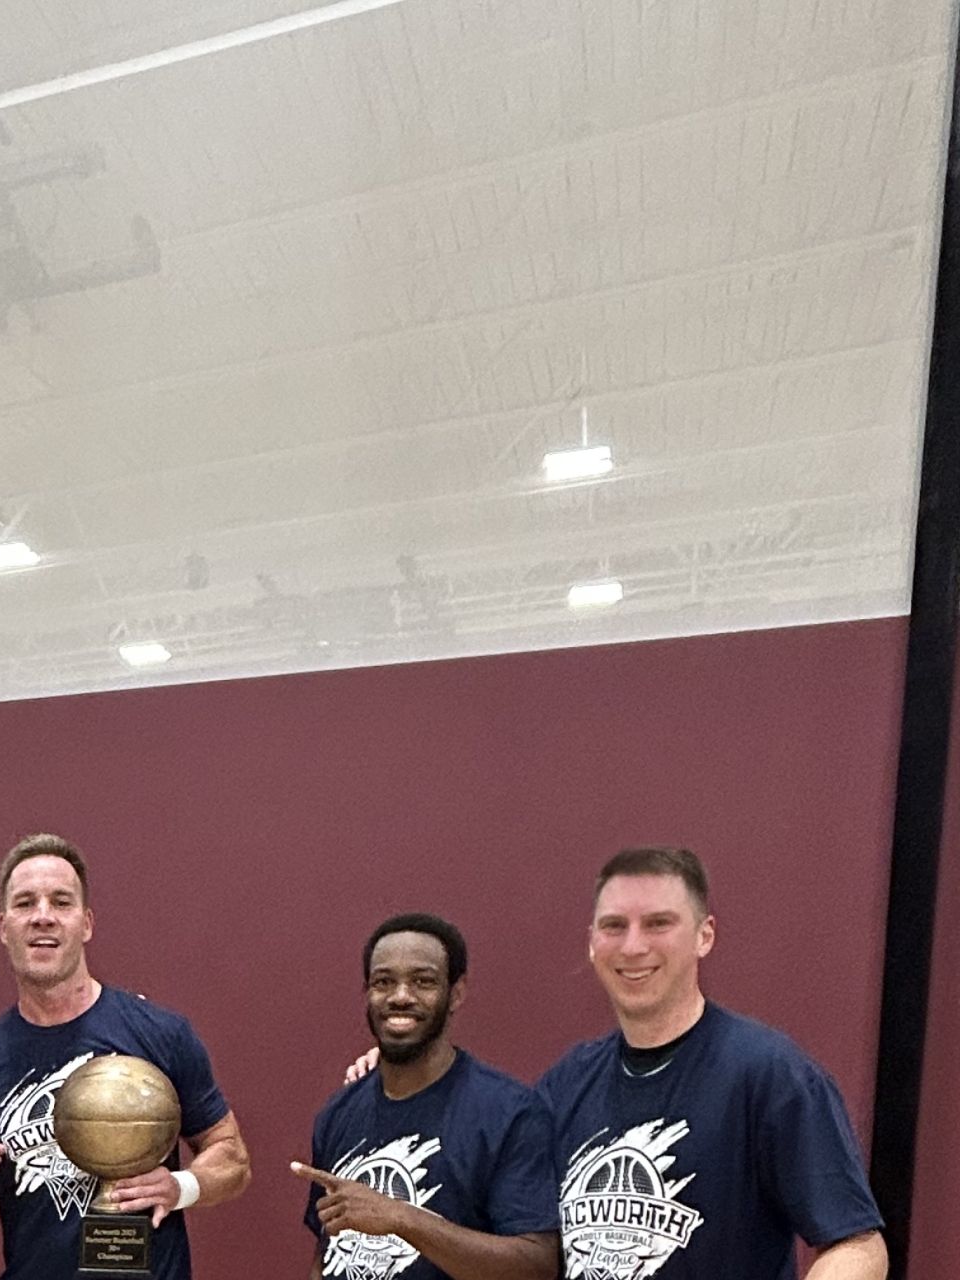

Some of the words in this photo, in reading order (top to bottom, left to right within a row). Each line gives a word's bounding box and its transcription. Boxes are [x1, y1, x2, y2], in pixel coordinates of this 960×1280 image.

[563, 1198, 689, 1238] ACWORTH
[604, 1231, 653, 1249] BASKETBALL
[351, 1243, 390, 1269] League
[589, 1244, 635, 1270] League
